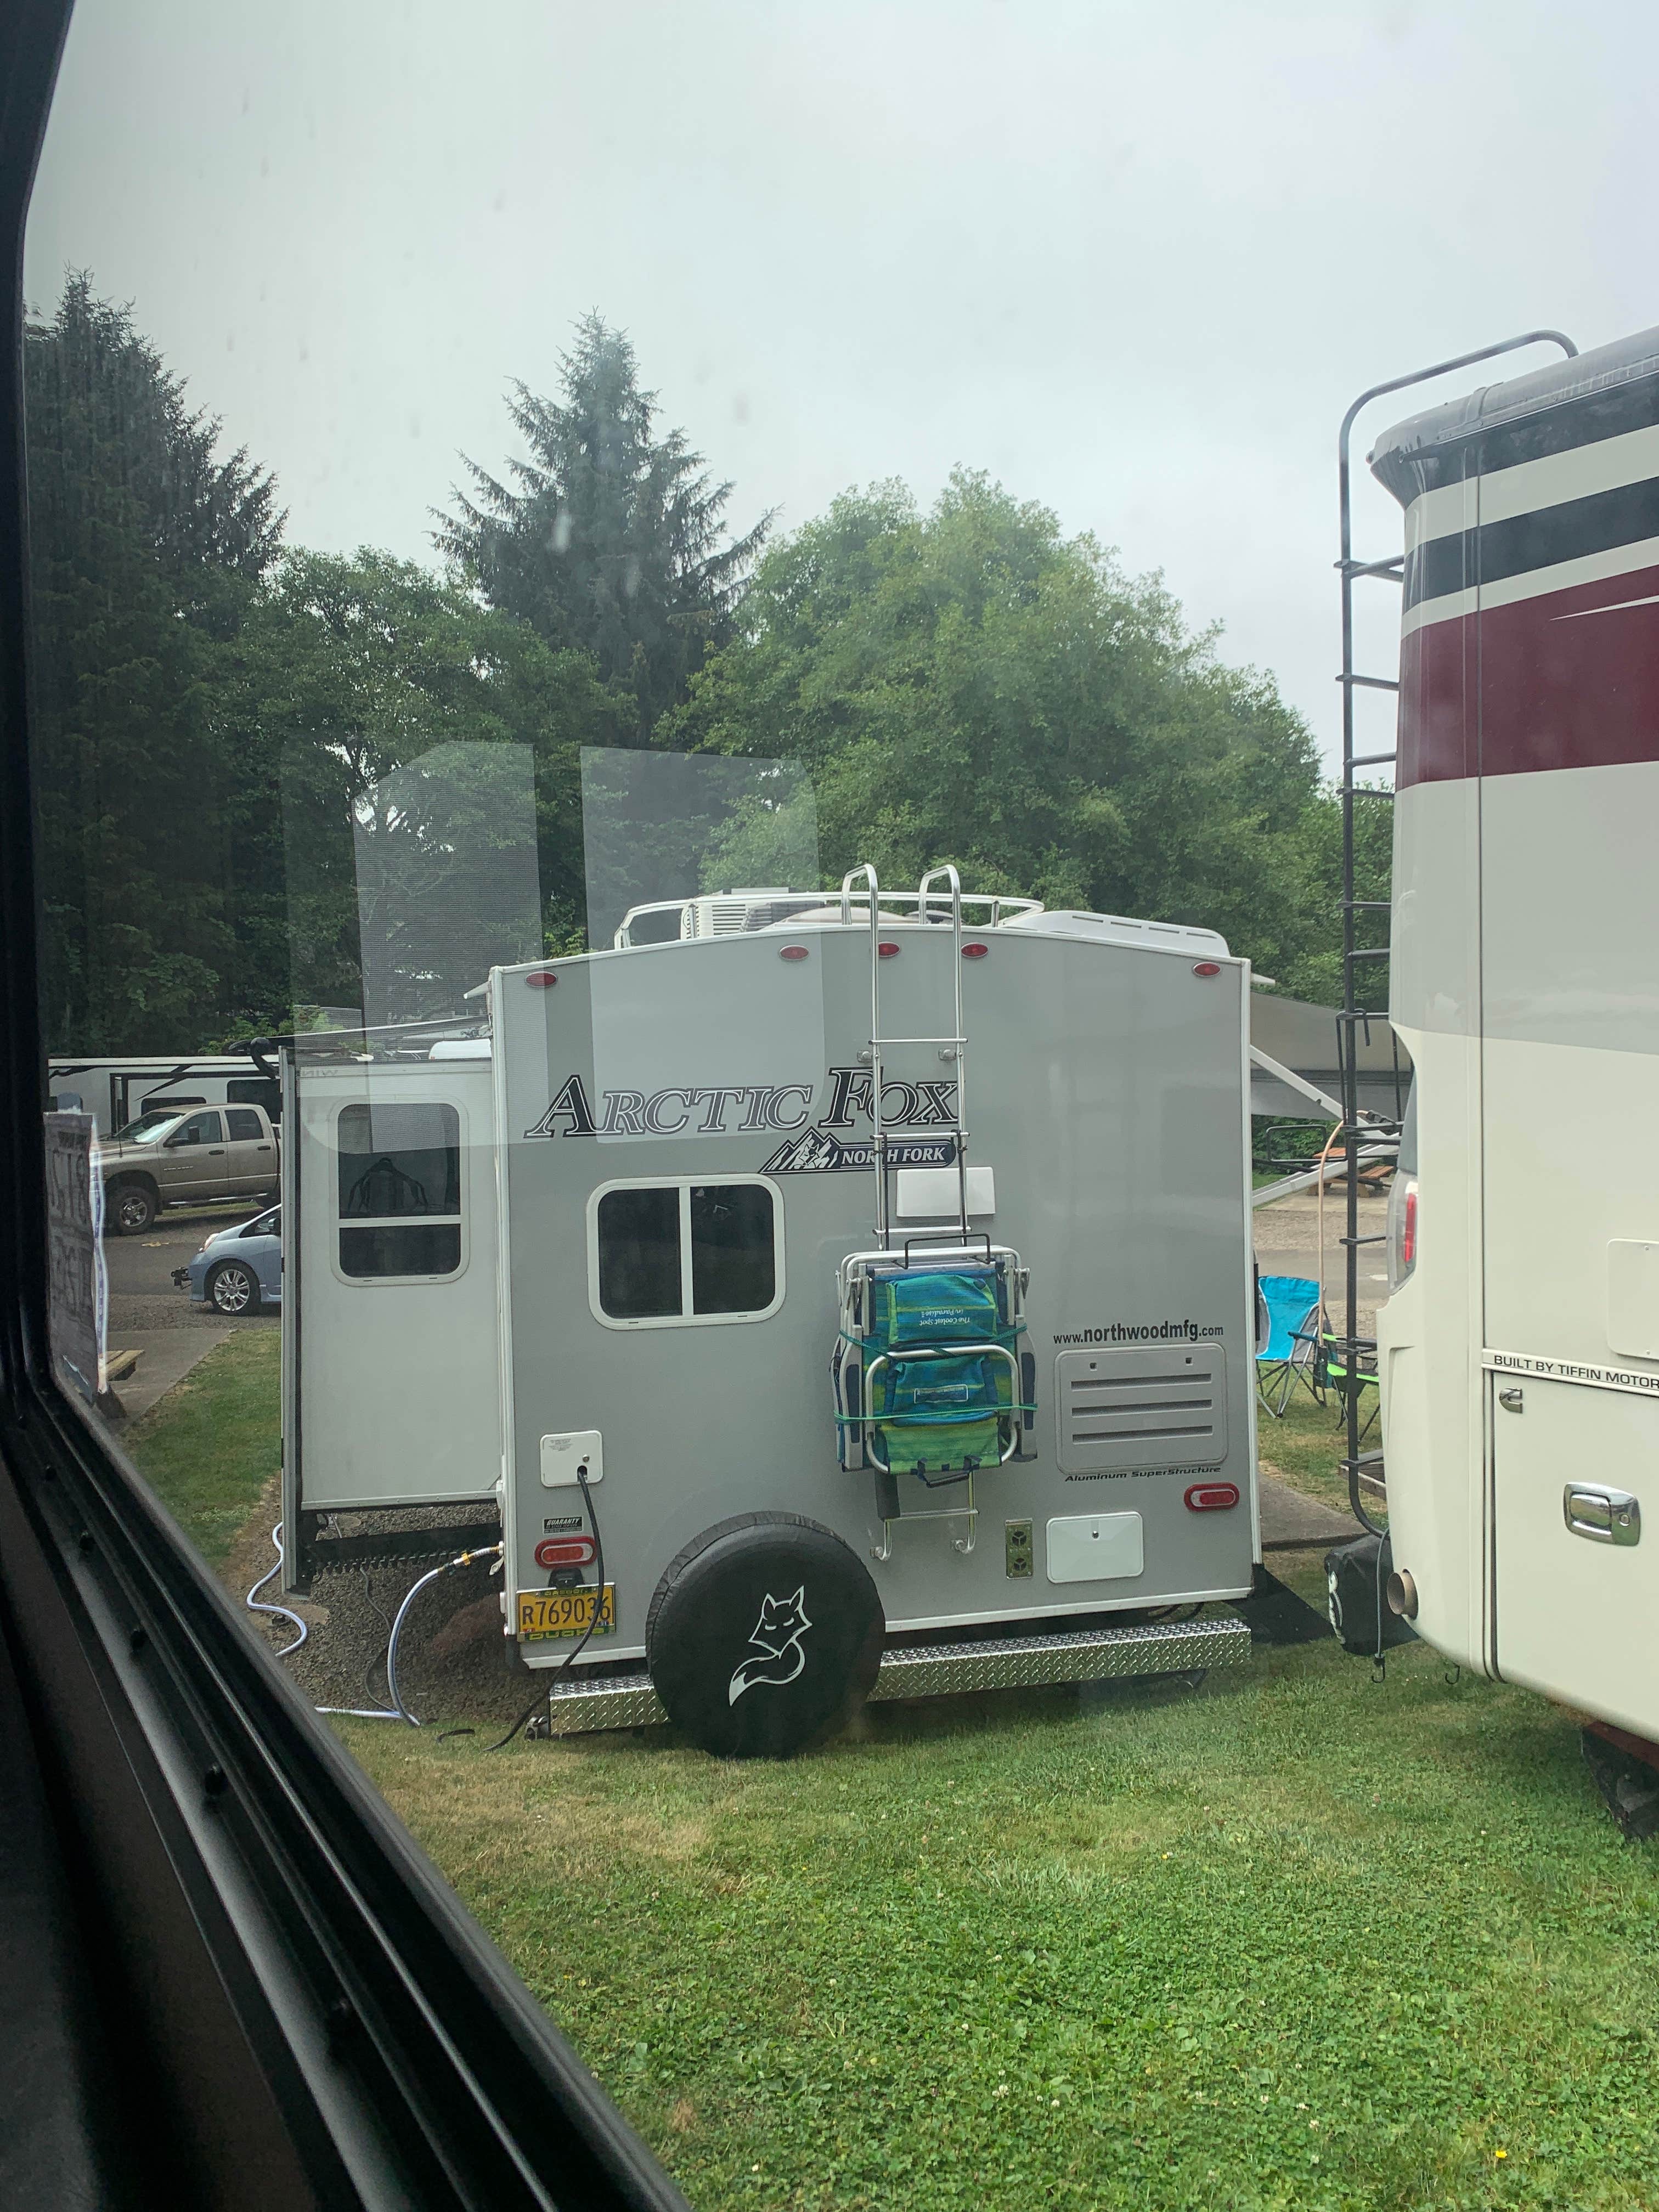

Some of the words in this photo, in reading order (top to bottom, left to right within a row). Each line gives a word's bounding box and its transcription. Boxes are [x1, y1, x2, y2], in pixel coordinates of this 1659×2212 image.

[523, 1074, 814, 1138] ARCTIC
[817, 1066, 963, 1128] FOX
[841, 1149, 898, 1165] NORH
[901, 1147, 946, 1162] FORK
[1053, 1319, 1224, 1344] www.northwoodmfg.com
[1494, 1355, 1532, 1369] BUILT
[1536, 1362, 1554, 1372] BY
[1558, 1364, 1601, 1380] TIFFIN
[1065, 1472, 1127, 1482] Aluminum
[522, 1596, 611, 1626] R769036
